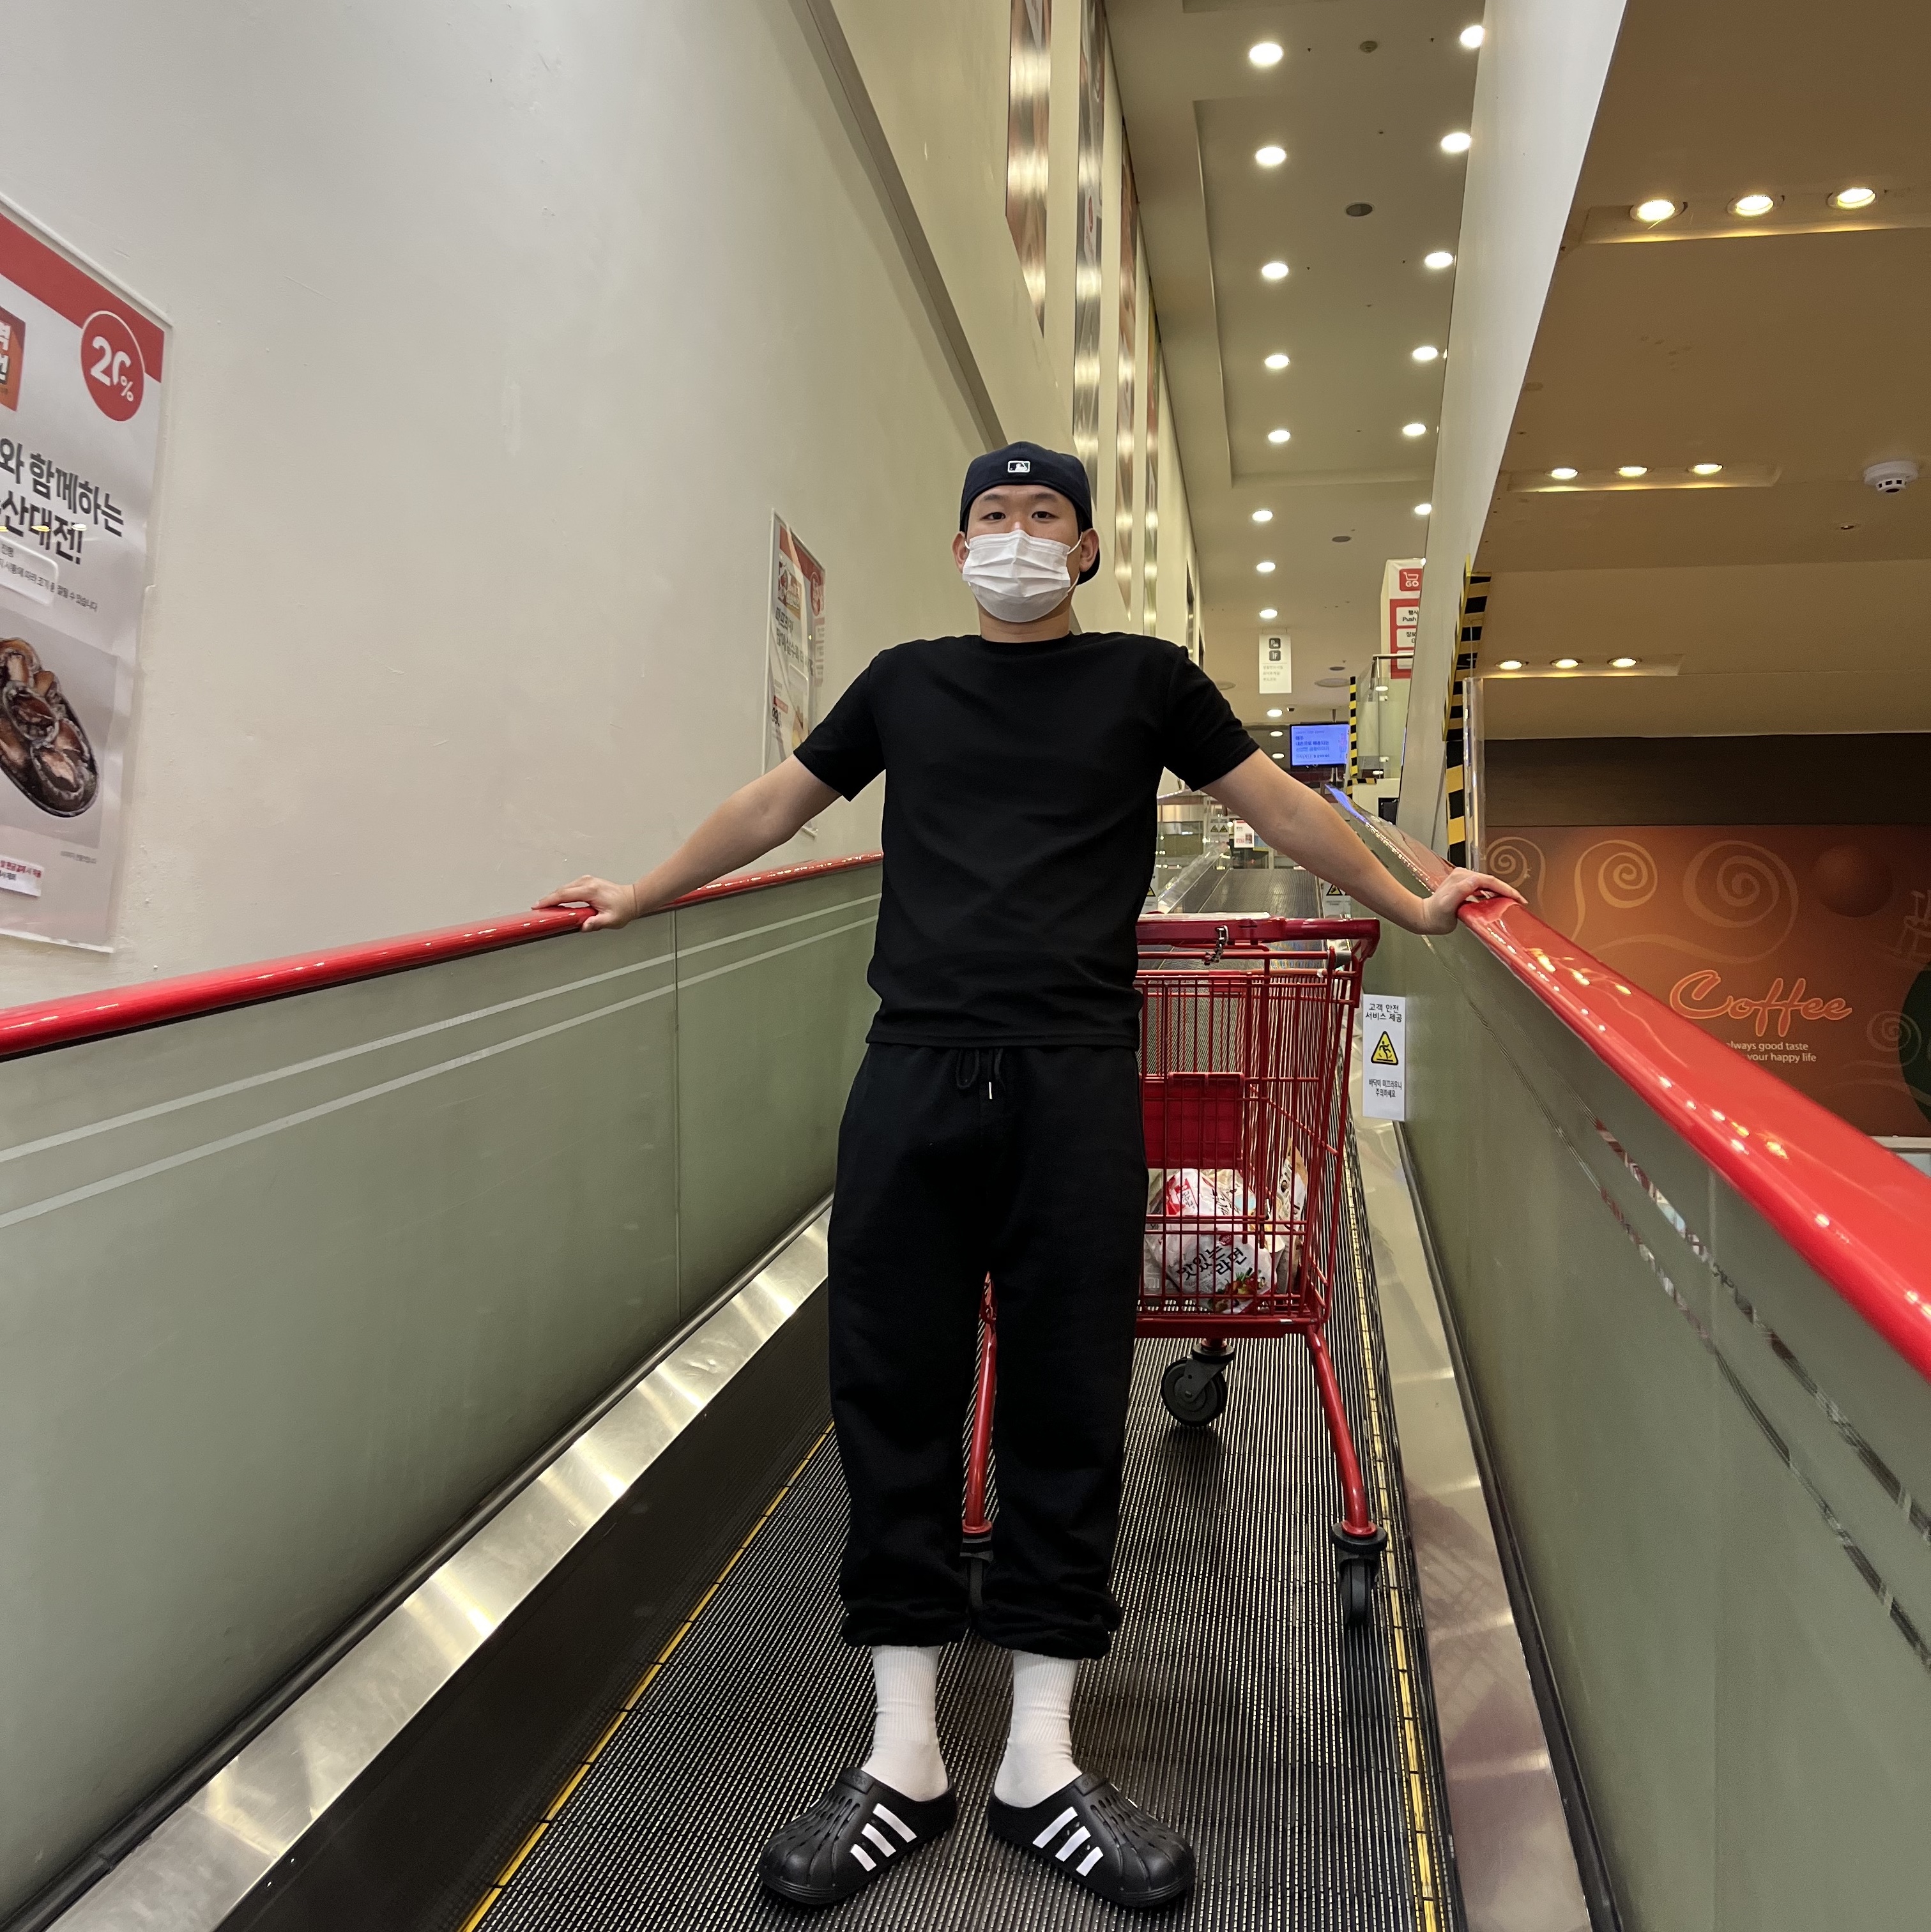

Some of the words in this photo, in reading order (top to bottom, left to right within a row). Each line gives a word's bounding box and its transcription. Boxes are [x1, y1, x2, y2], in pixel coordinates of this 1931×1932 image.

[30, 452, 124, 537] 함께하는
[1369, 1003, 1383, 1012] 고객
[1385, 1004, 1399, 1014] 안전
[1669, 969, 1852, 1037] Coffee
[1365, 1012, 1387, 1021] 서비스
[1389, 1014, 1402, 1023] 제공
[1759, 1042, 1784, 1052] good
[1785, 1042, 1809, 1051] taste
[1770, 1052, 1800, 1064] happy
[1802, 1053, 1817, 1062] life
[1176, 1245, 1226, 1281] 맛있는
[1216, 1247, 1248, 1275] 라면
